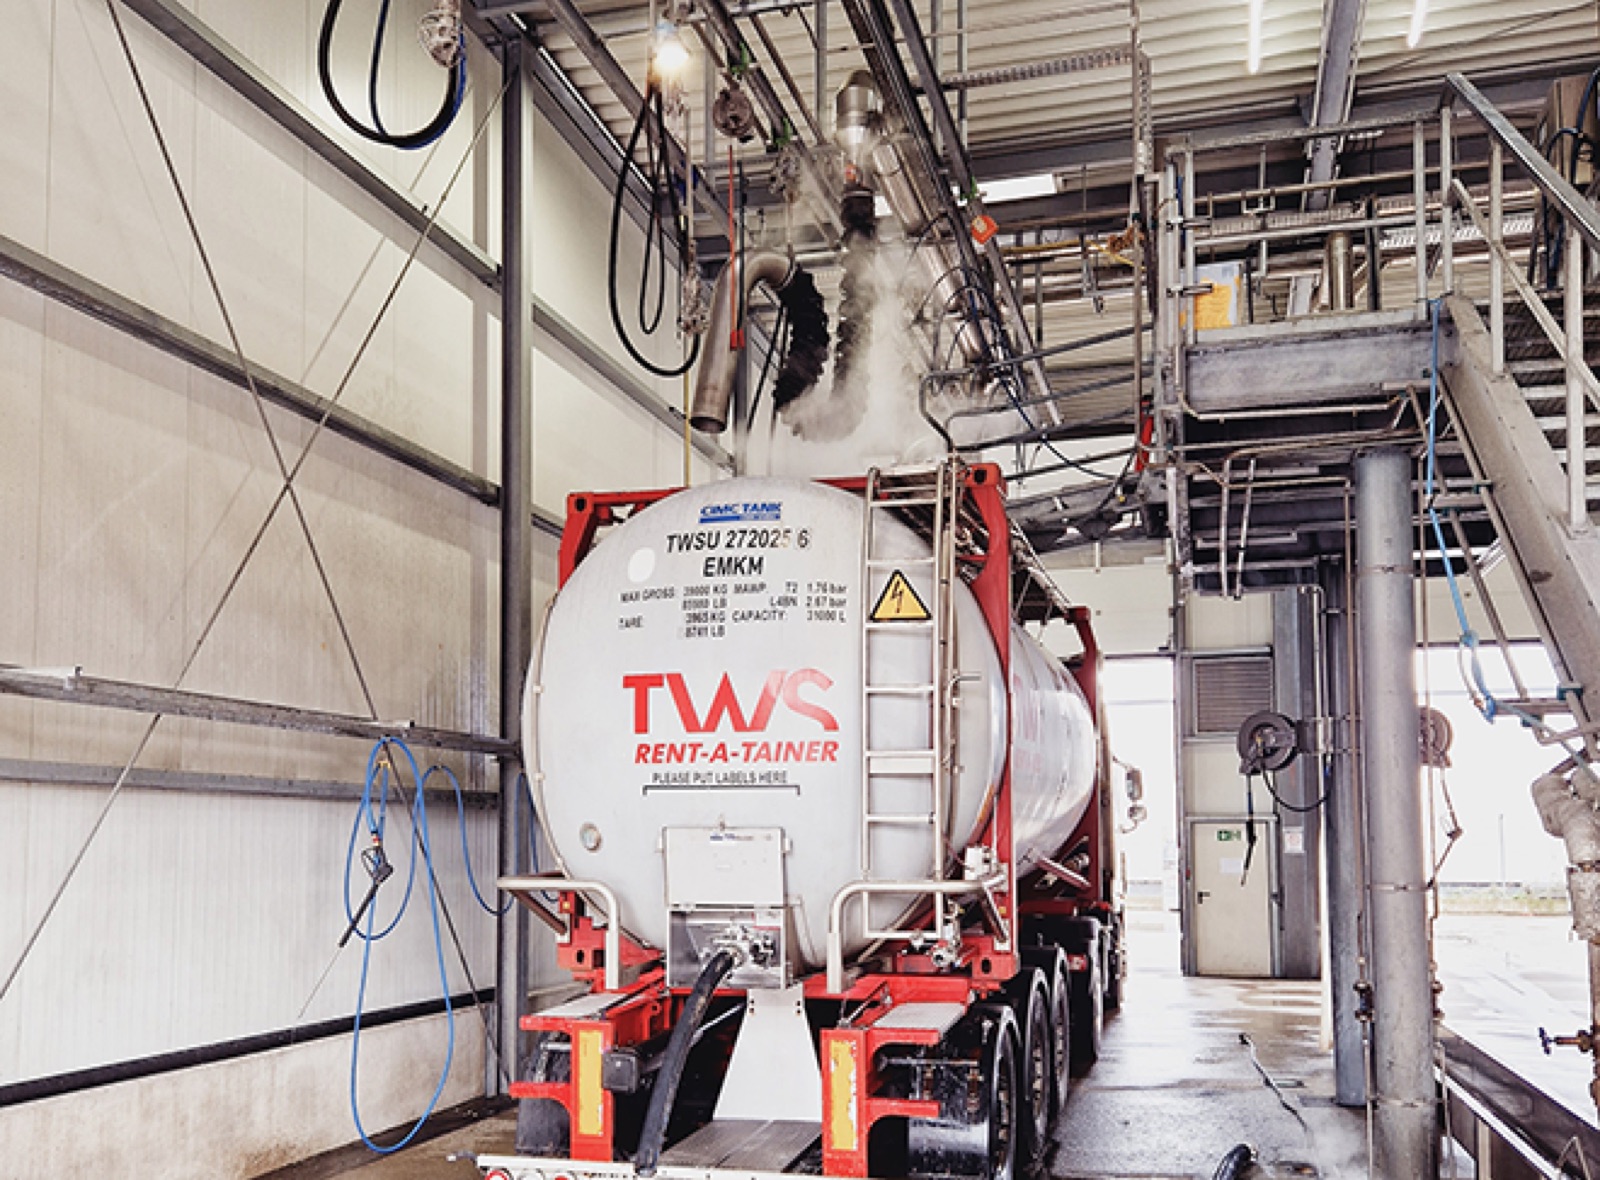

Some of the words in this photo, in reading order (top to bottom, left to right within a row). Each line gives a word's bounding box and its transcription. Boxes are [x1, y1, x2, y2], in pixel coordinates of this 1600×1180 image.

[700, 503, 740, 516] CIMC
[742, 502, 782, 512] TANK
[666, 530, 720, 552] TWSU
[724, 529, 791, 549] 272025
[702, 556, 764, 578] EMKM
[712, 584, 728, 594] KG
[623, 668, 840, 734] TWS
[634, 741, 839, 764] RENT-A-TAINER
[652, 772, 690, 783] PLEASE
[693, 772, 713, 783] PUT
[715, 771, 756, 783] LABELS
[758, 770, 788, 783] HERE
